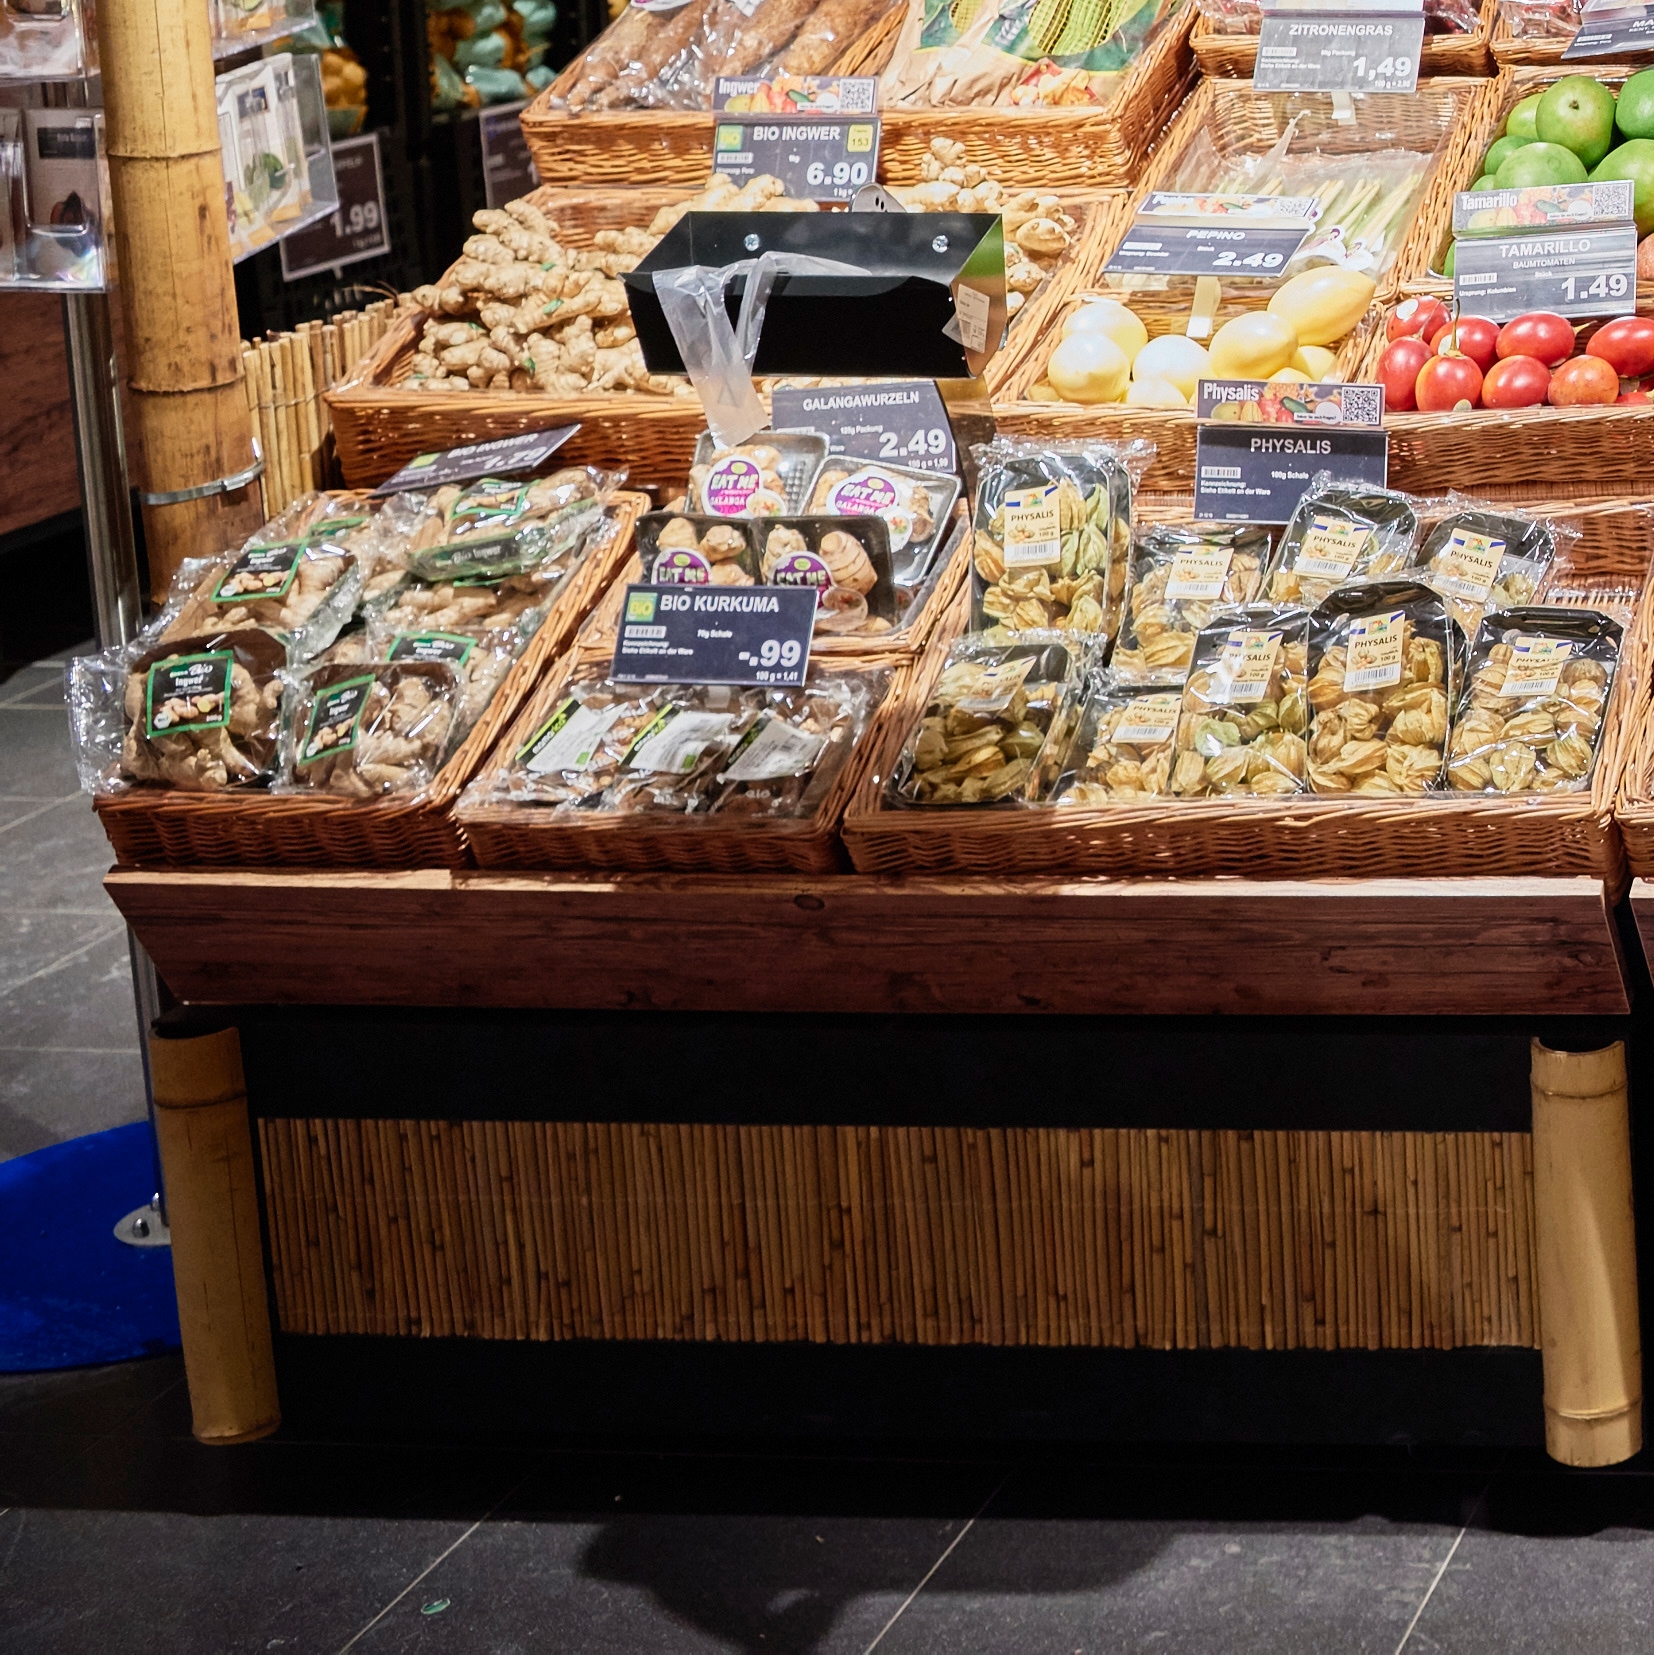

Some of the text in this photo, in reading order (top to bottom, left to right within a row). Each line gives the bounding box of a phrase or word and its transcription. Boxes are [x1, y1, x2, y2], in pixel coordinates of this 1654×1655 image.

[1289, 24, 1393, 37] ZITRONENGRAS
[1353, 56, 1411, 78] 1,49
[719, 78, 759, 95] Ingwer
[753, 126, 841, 142] BIO INGWER
[852, 138, 869, 147] 153
[807, 162, 868, 186] 6.90
[1460, 191, 1518, 210] Tamarillo
[1186, 230, 1245, 241] PEPINO
[1499, 237, 1591, 258] TAMARILLO
[1213, 251, 1284, 268] 2.49
[1512, 257, 1576, 269] BAUMTOMATEN
[1561, 274, 1628, 301] 1.49
[803, 391, 919, 412] GALANGAWURZELN
[1203, 382, 1260, 402] Physalis
[879, 429, 947, 458] 2.49
[1251, 438, 1331, 454] PHYSALIS
[1010, 506, 1055, 526] PHYSALIS
[660, 595, 779, 613] BIO KURKUMA
[1354, 633, 1398, 652] PHYSALIS
[739, 640, 801, 667] -.99
